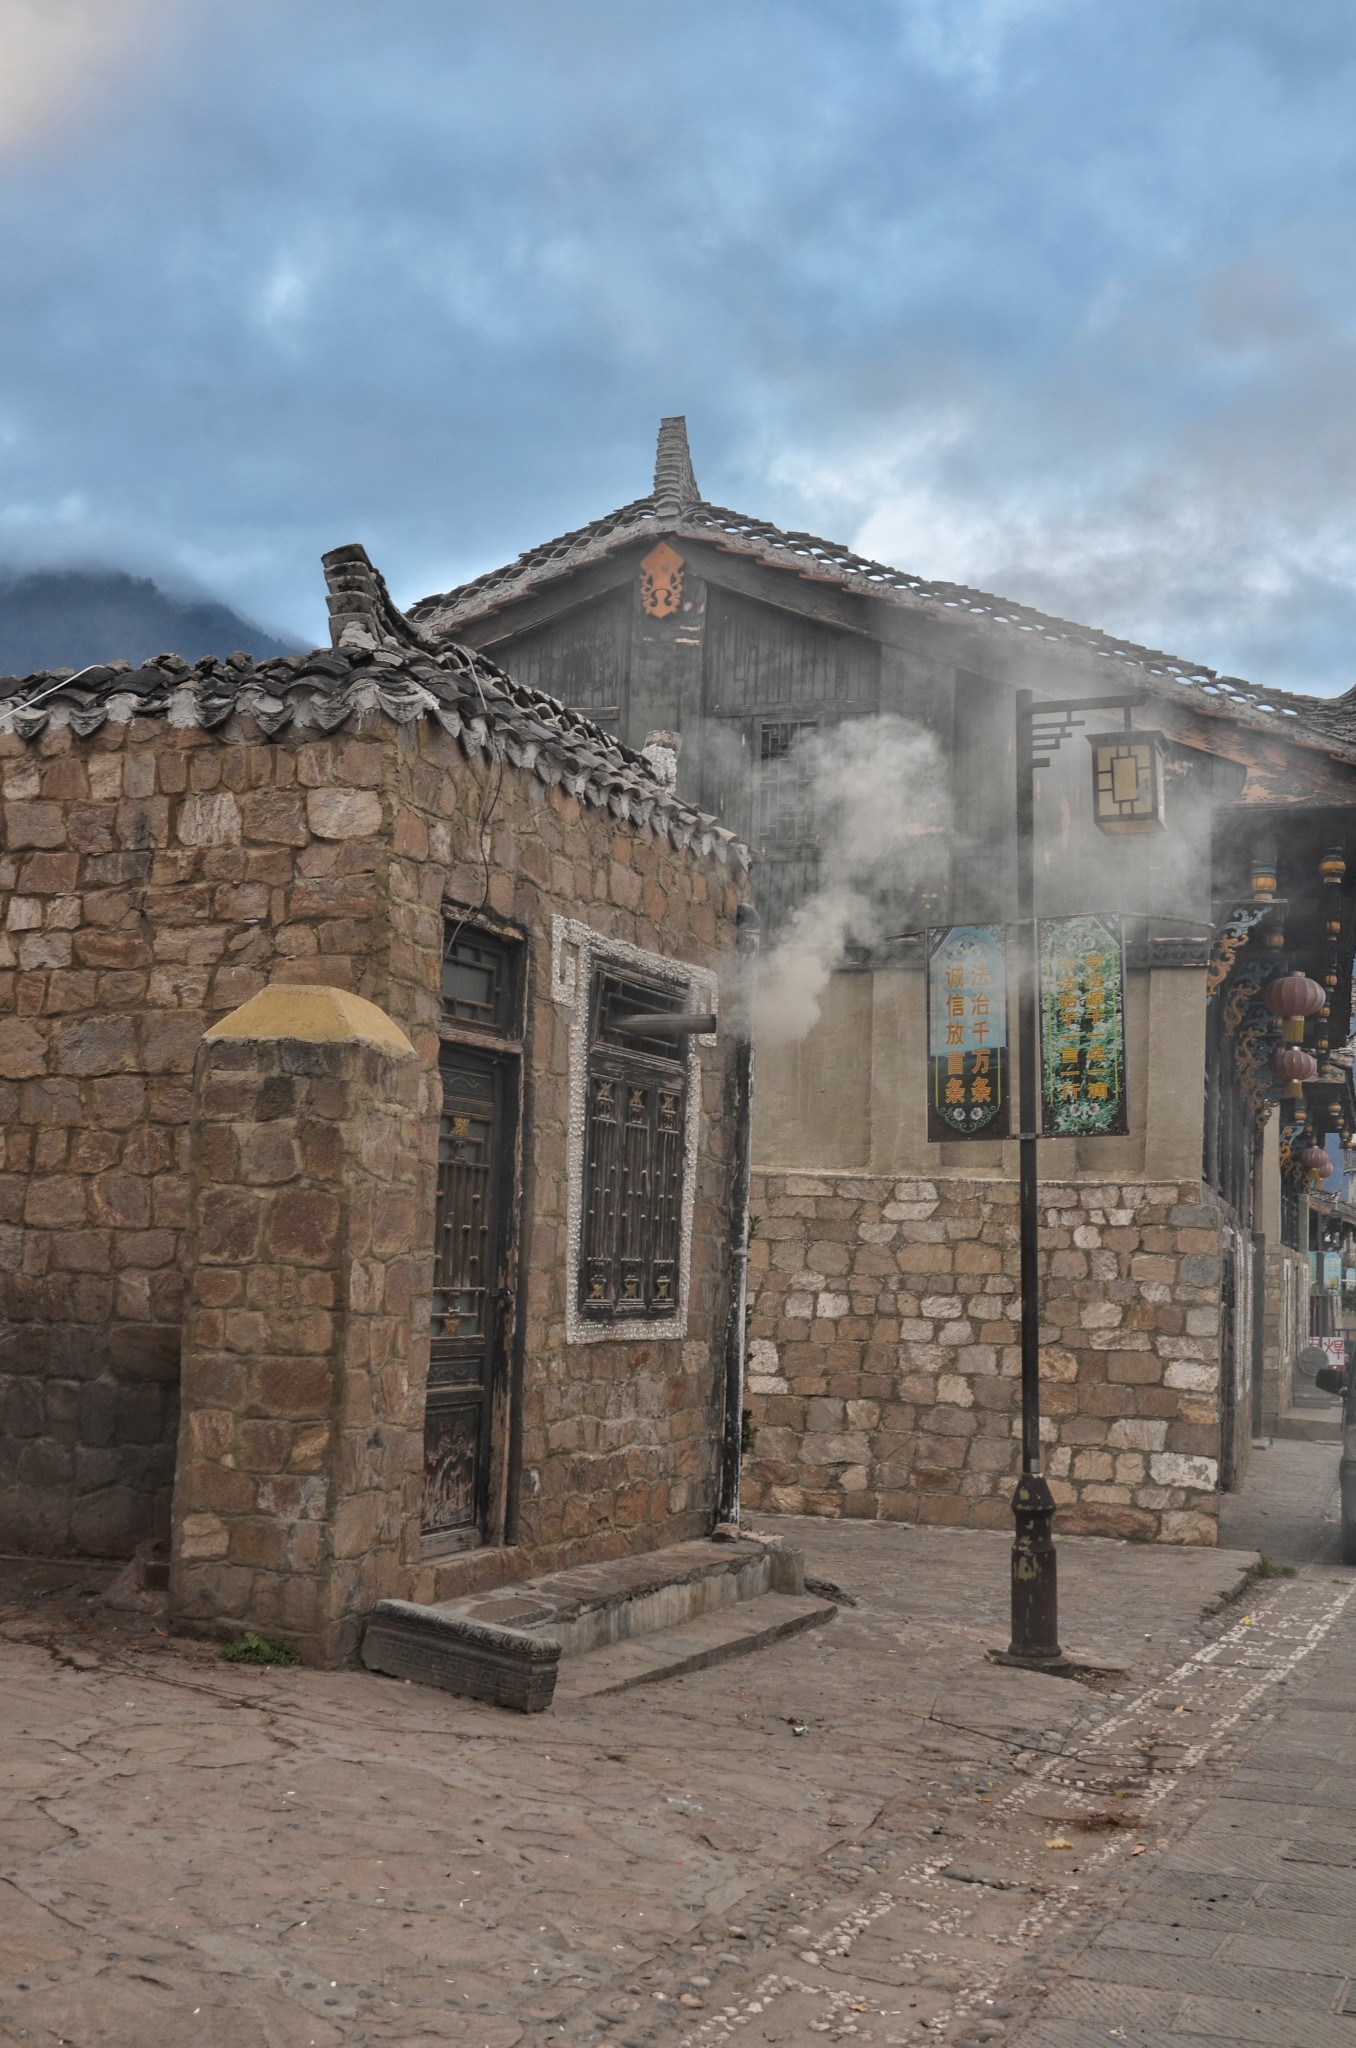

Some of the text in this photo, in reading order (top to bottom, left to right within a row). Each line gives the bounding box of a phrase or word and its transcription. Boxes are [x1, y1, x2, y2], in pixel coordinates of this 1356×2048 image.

[945, 965, 966, 1104] 诚信放首条
[971, 964, 992, 1103] 法治千万条
